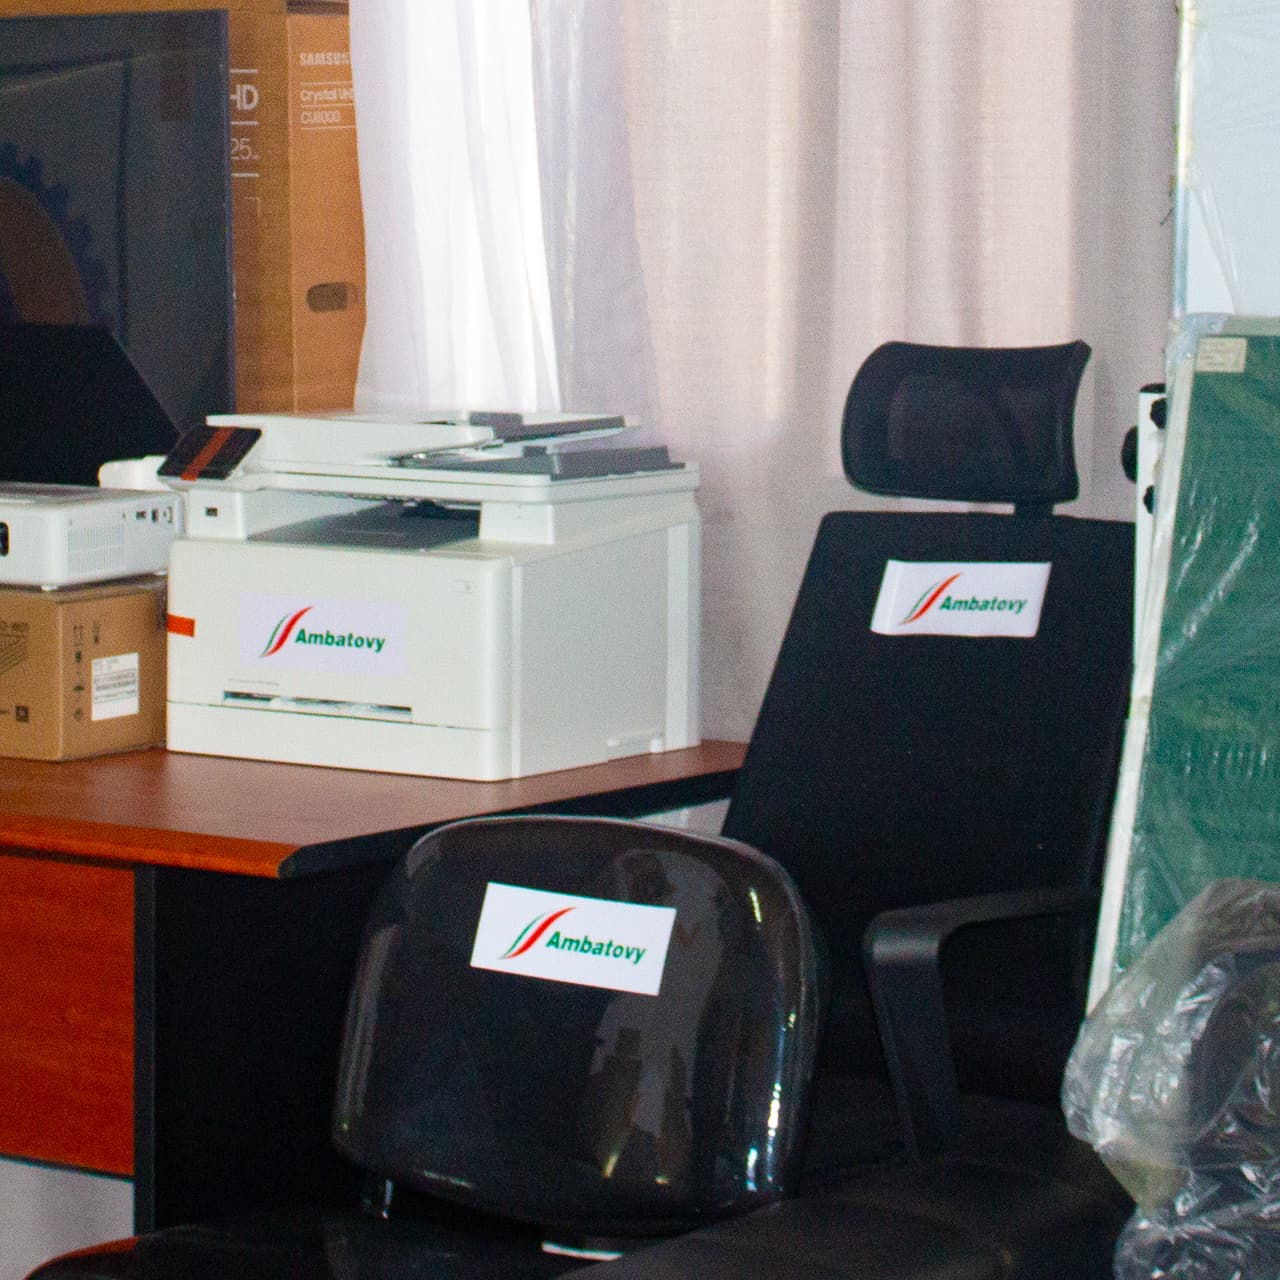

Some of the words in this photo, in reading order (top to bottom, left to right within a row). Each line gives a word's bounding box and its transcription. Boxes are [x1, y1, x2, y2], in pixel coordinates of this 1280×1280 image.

[300, 89, 337, 108] Crystal
[939, 595, 1028, 614] Ambatovy
[294, 628, 386, 652] Ambatovy
[545, 931, 646, 965] Ambatovy
